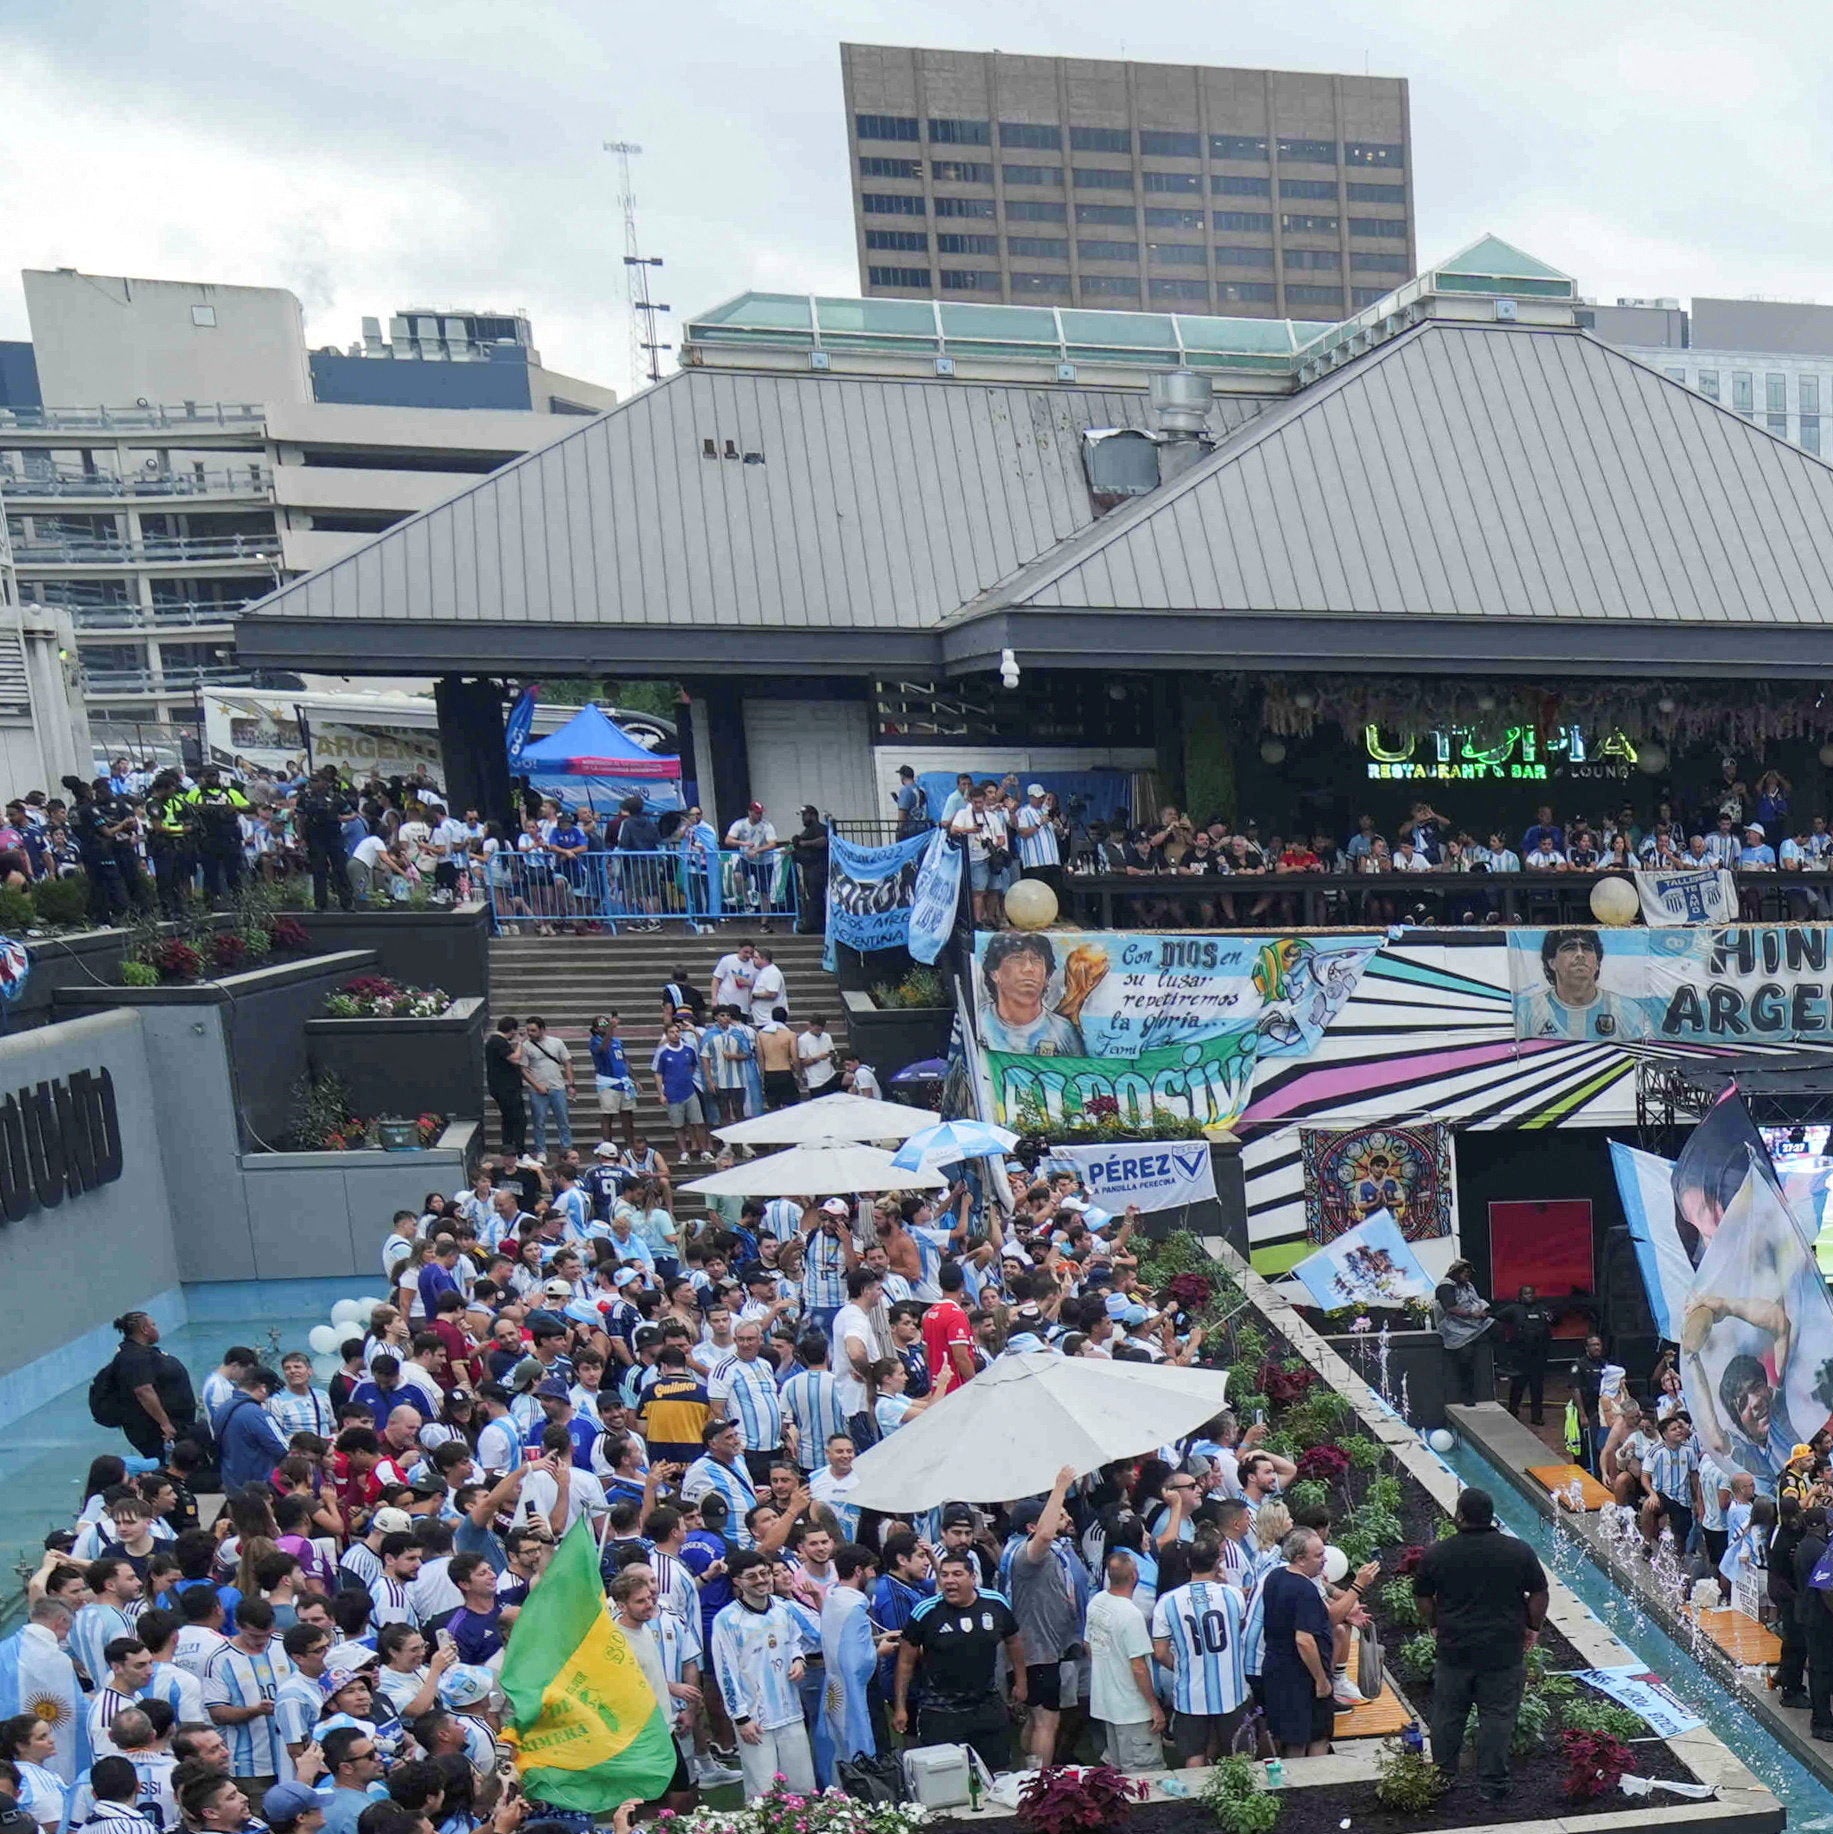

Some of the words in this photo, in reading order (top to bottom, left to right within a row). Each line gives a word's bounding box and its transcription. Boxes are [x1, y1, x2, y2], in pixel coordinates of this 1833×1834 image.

[1368, 762, 1486, 780] RESTAURANT
[1511, 763, 1547, 780] BAR
[1121, 942, 1152, 966] Con
[1219, 950, 1242, 966] en
[1122, 973, 1147, 988] su
[1122, 991, 1240, 1010] repetiremos
[1110, 1010, 1130, 1032] la
[1781, 1141, 1806, 1154] 27:27
[1088, 1153, 1171, 1184] PÉREZ
[602, 1178, 617, 1199] 9
[1183, 1610, 1227, 1657] 10
